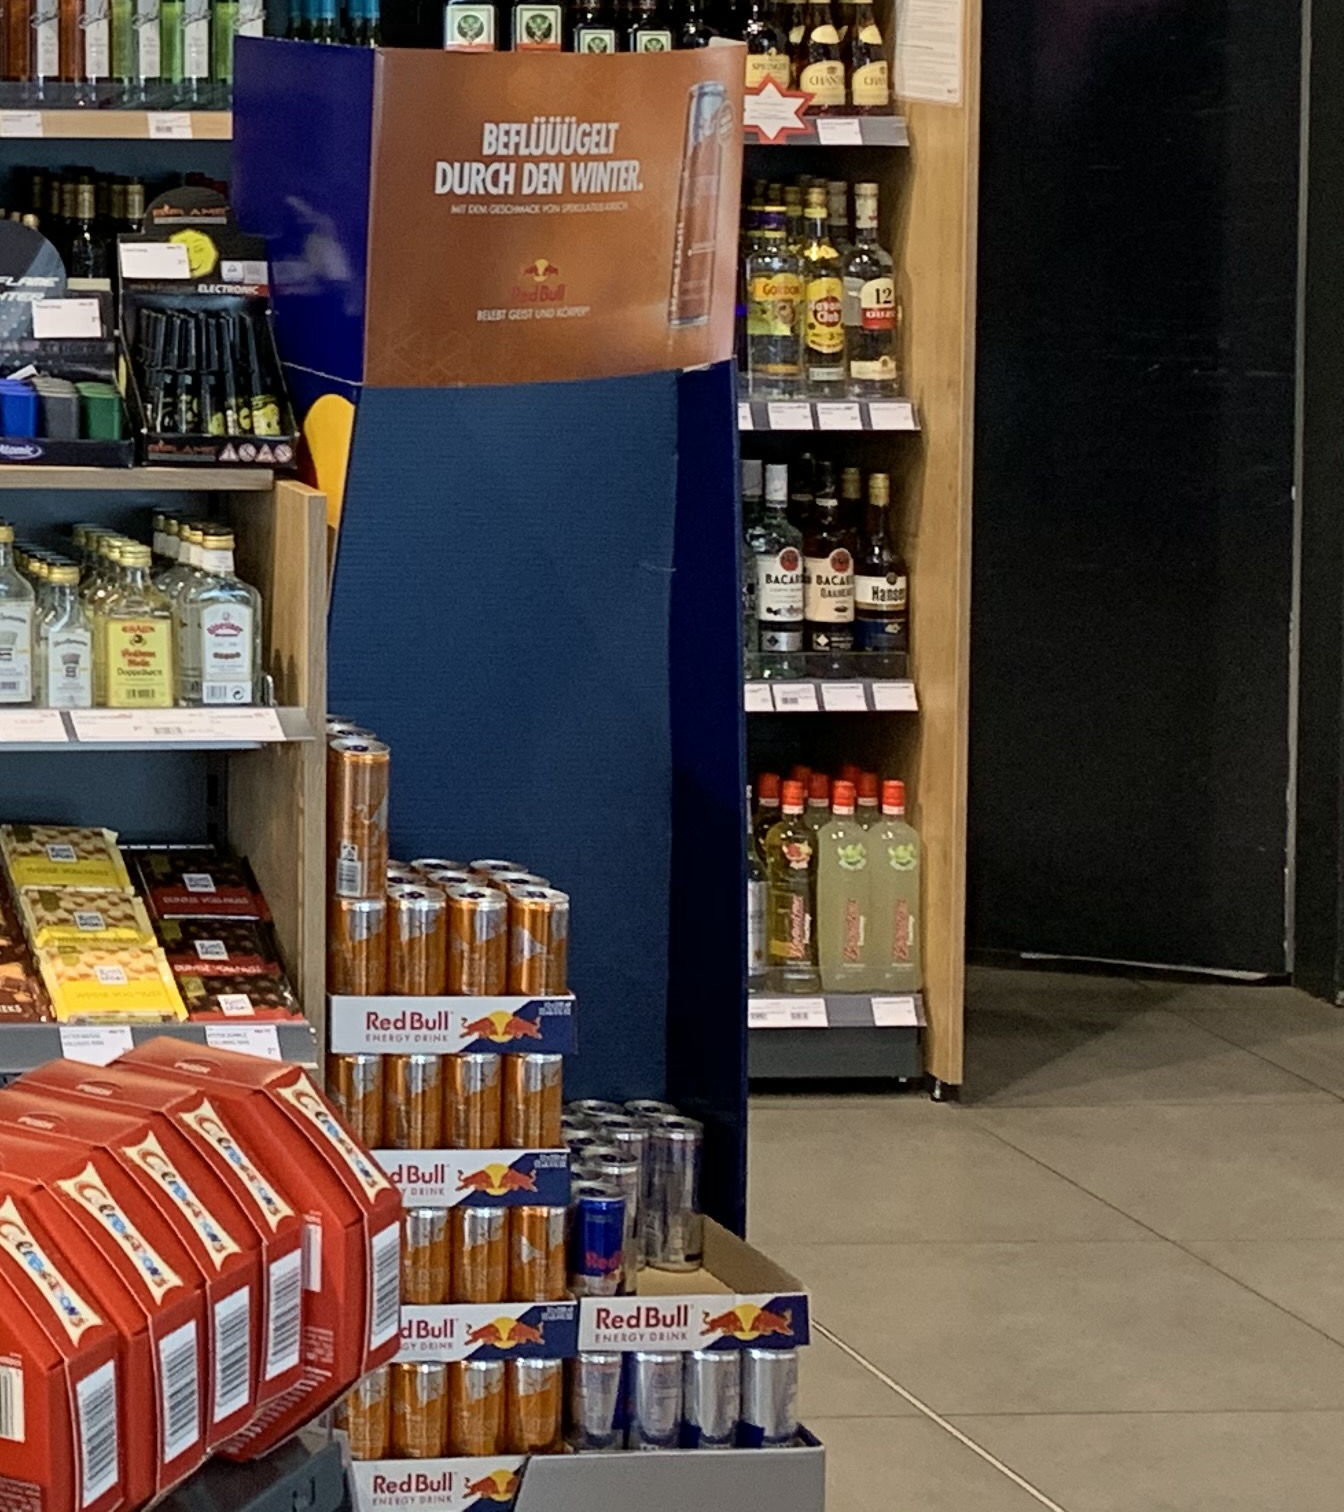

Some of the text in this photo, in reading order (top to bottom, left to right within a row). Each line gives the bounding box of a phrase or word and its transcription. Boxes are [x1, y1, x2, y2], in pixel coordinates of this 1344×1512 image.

[483, 116, 619, 156] BEFLÜÜÜGELT
[435, 160, 644, 195] DURCH DEN WINTER.
[451, 204, 466, 215] MIT
[489, 203, 540, 215] GESCHMACK
[542, 202, 560, 213] VON
[197, 284, 259, 295] ELECTRONIC
[512, 284, 566, 303] Red Bull
[874, 287, 892, 304] 12
[477, 308, 554, 321] BELEBT GEIST UND
[366, 1009, 450, 1031] Red Bull
[365, 1034, 448, 1043] ENERGY DRINK
[413, 1164, 445, 1185] Bull
[412, 1187, 445, 1196] DRINK
[596, 1304, 689, 1330] Red Bull
[417, 1318, 455, 1339] Bull
[595, 1330, 689, 1344] ENERGY DRINK
[420, 1340, 454, 1352] DRINK
[372, 1472, 455, 1495] Red Bull
[372, 1493, 454, 1507] ENERGY DRINK
